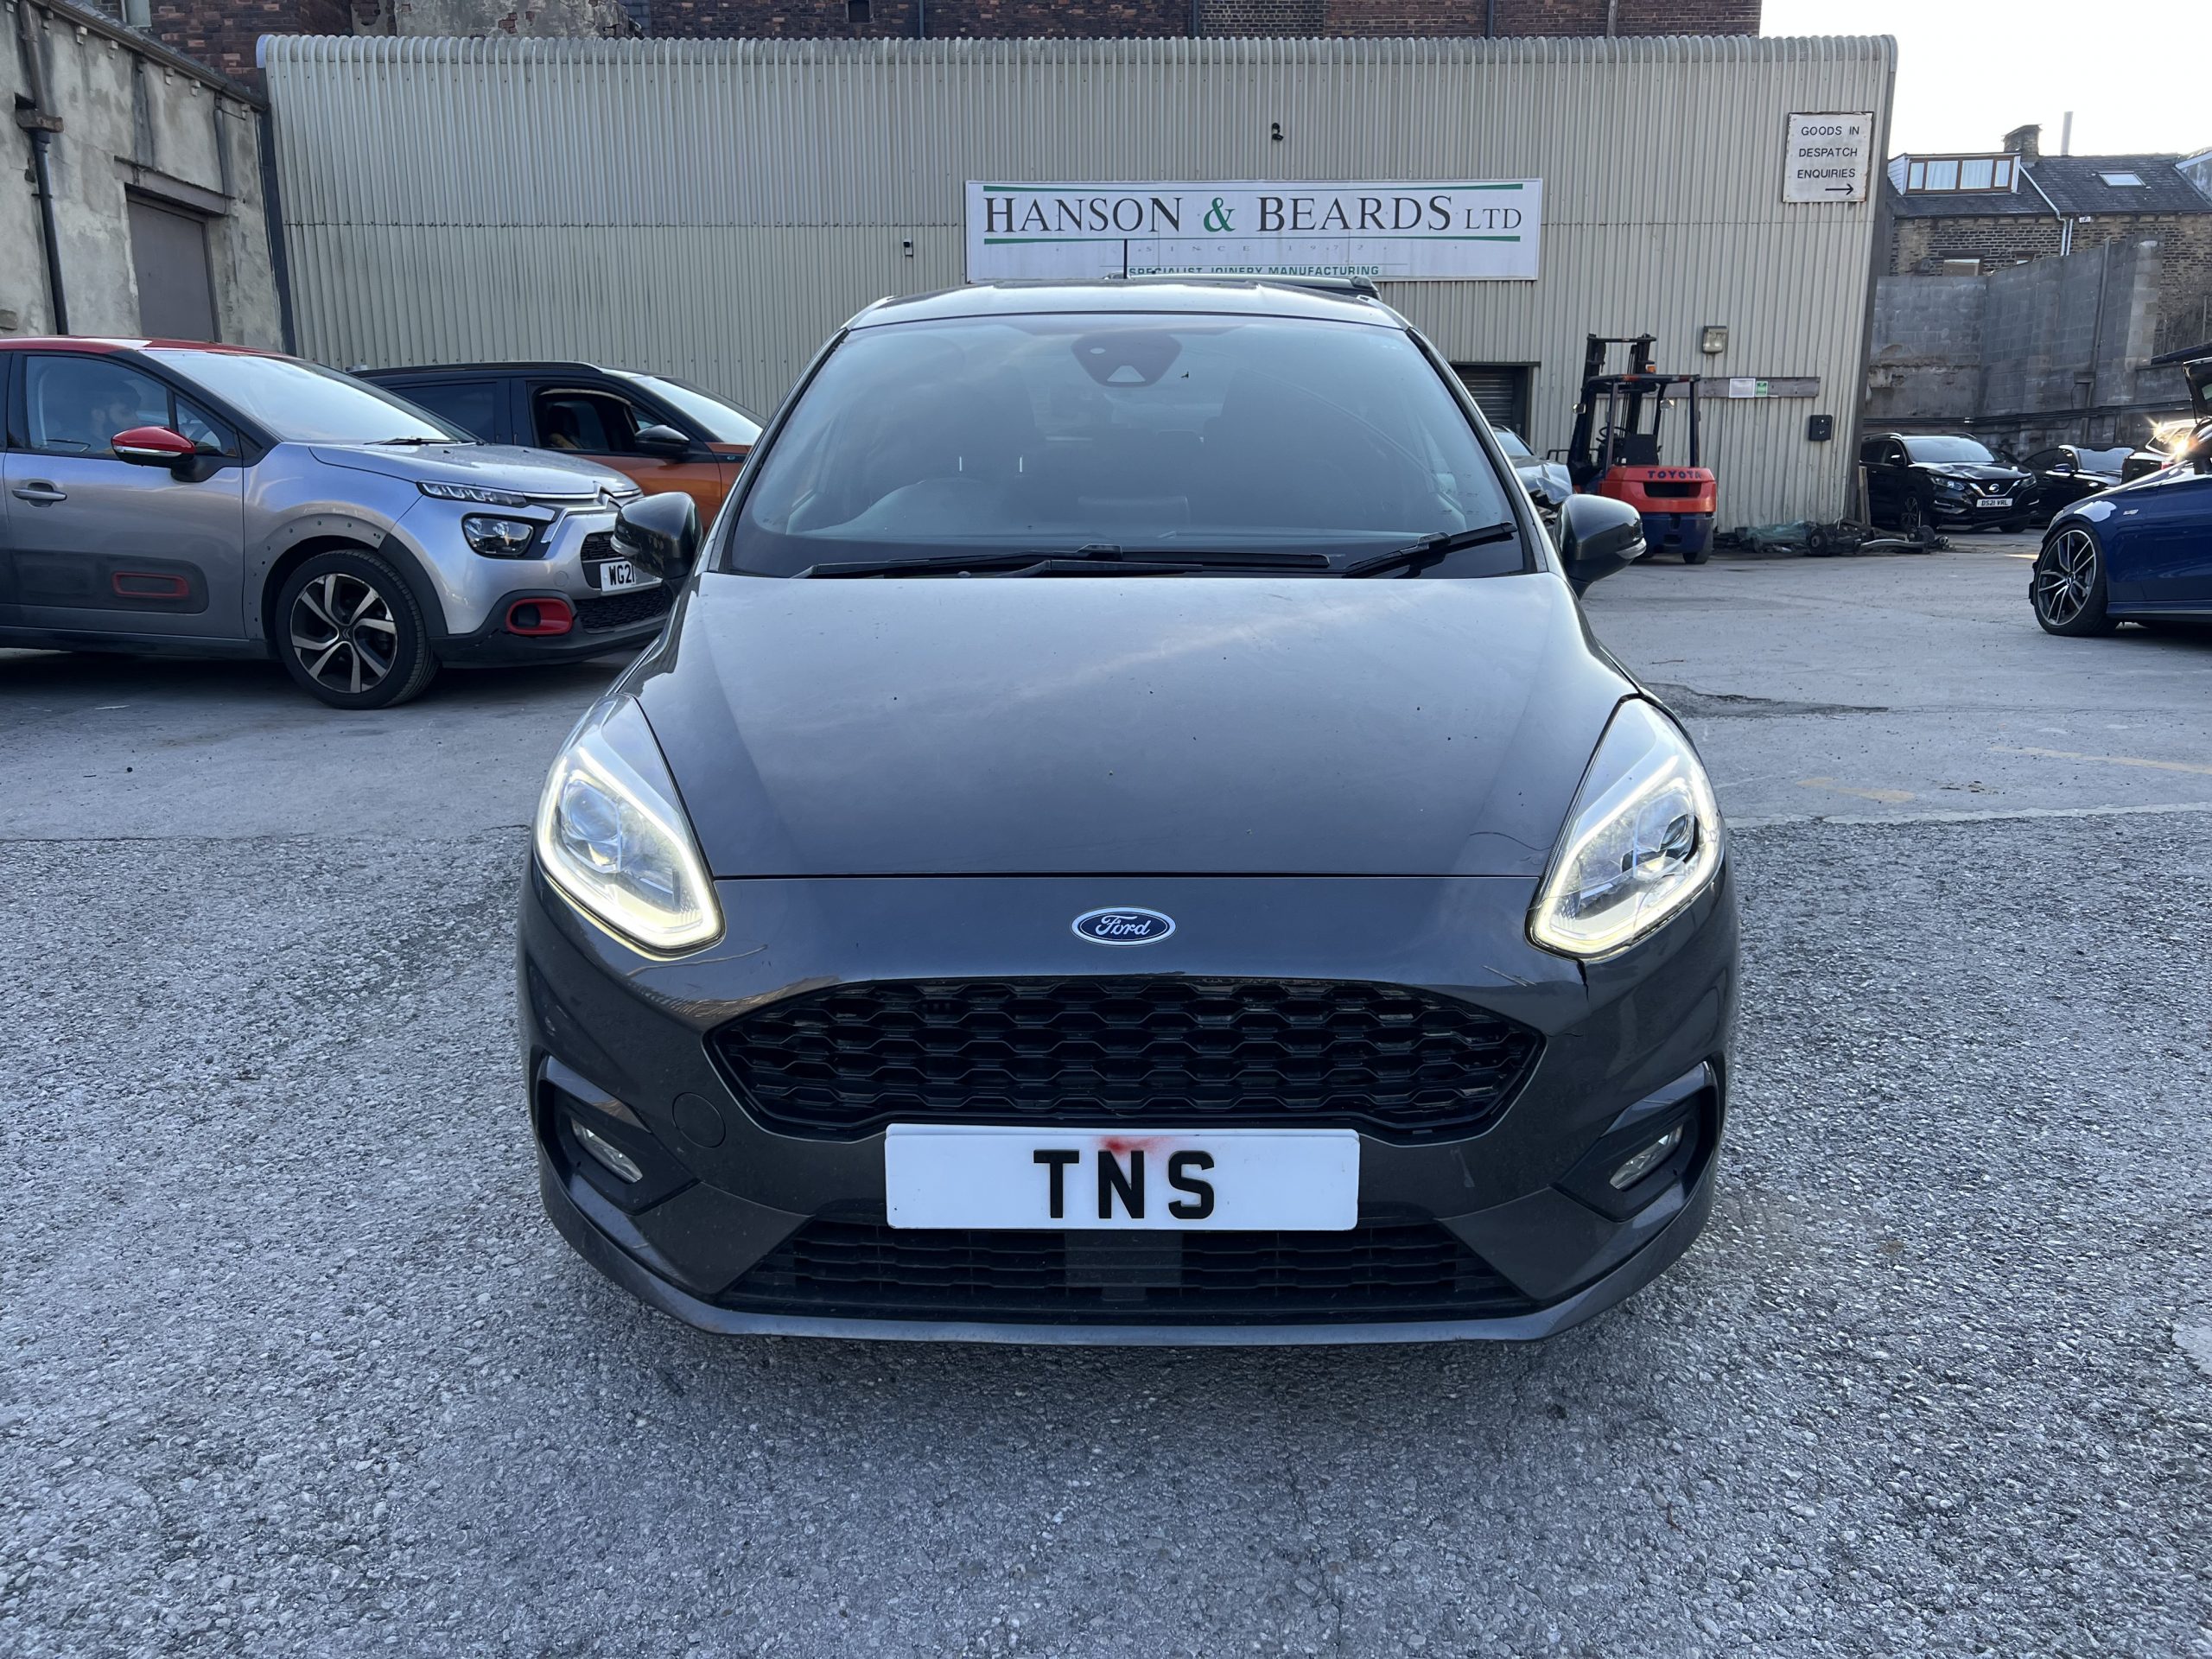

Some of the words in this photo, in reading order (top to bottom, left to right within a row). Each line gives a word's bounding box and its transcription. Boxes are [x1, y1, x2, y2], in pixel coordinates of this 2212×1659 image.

[1801, 126, 1842, 136] GOODS
[1849, 126, 1859, 135] IN
[1798, 148, 1858, 157] DESPATCH
[1797, 168, 1856, 179] ENQUIRIES
[983, 196, 1183, 233] HANSON
[1204, 196, 1236, 232] &
[1256, 195, 1452, 232] BEARDS
[1465, 208, 1522, 230] LTD
[1211, 266, 1263, 275] JOINERY
[1268, 265, 1379, 276] MANUFACTURING
[1648, 470, 1701, 479] TOYOTA
[608, 563, 635, 586] WG21
[1095, 915, 1152, 936] Ford
[1033, 1148, 1215, 1220] TNS
